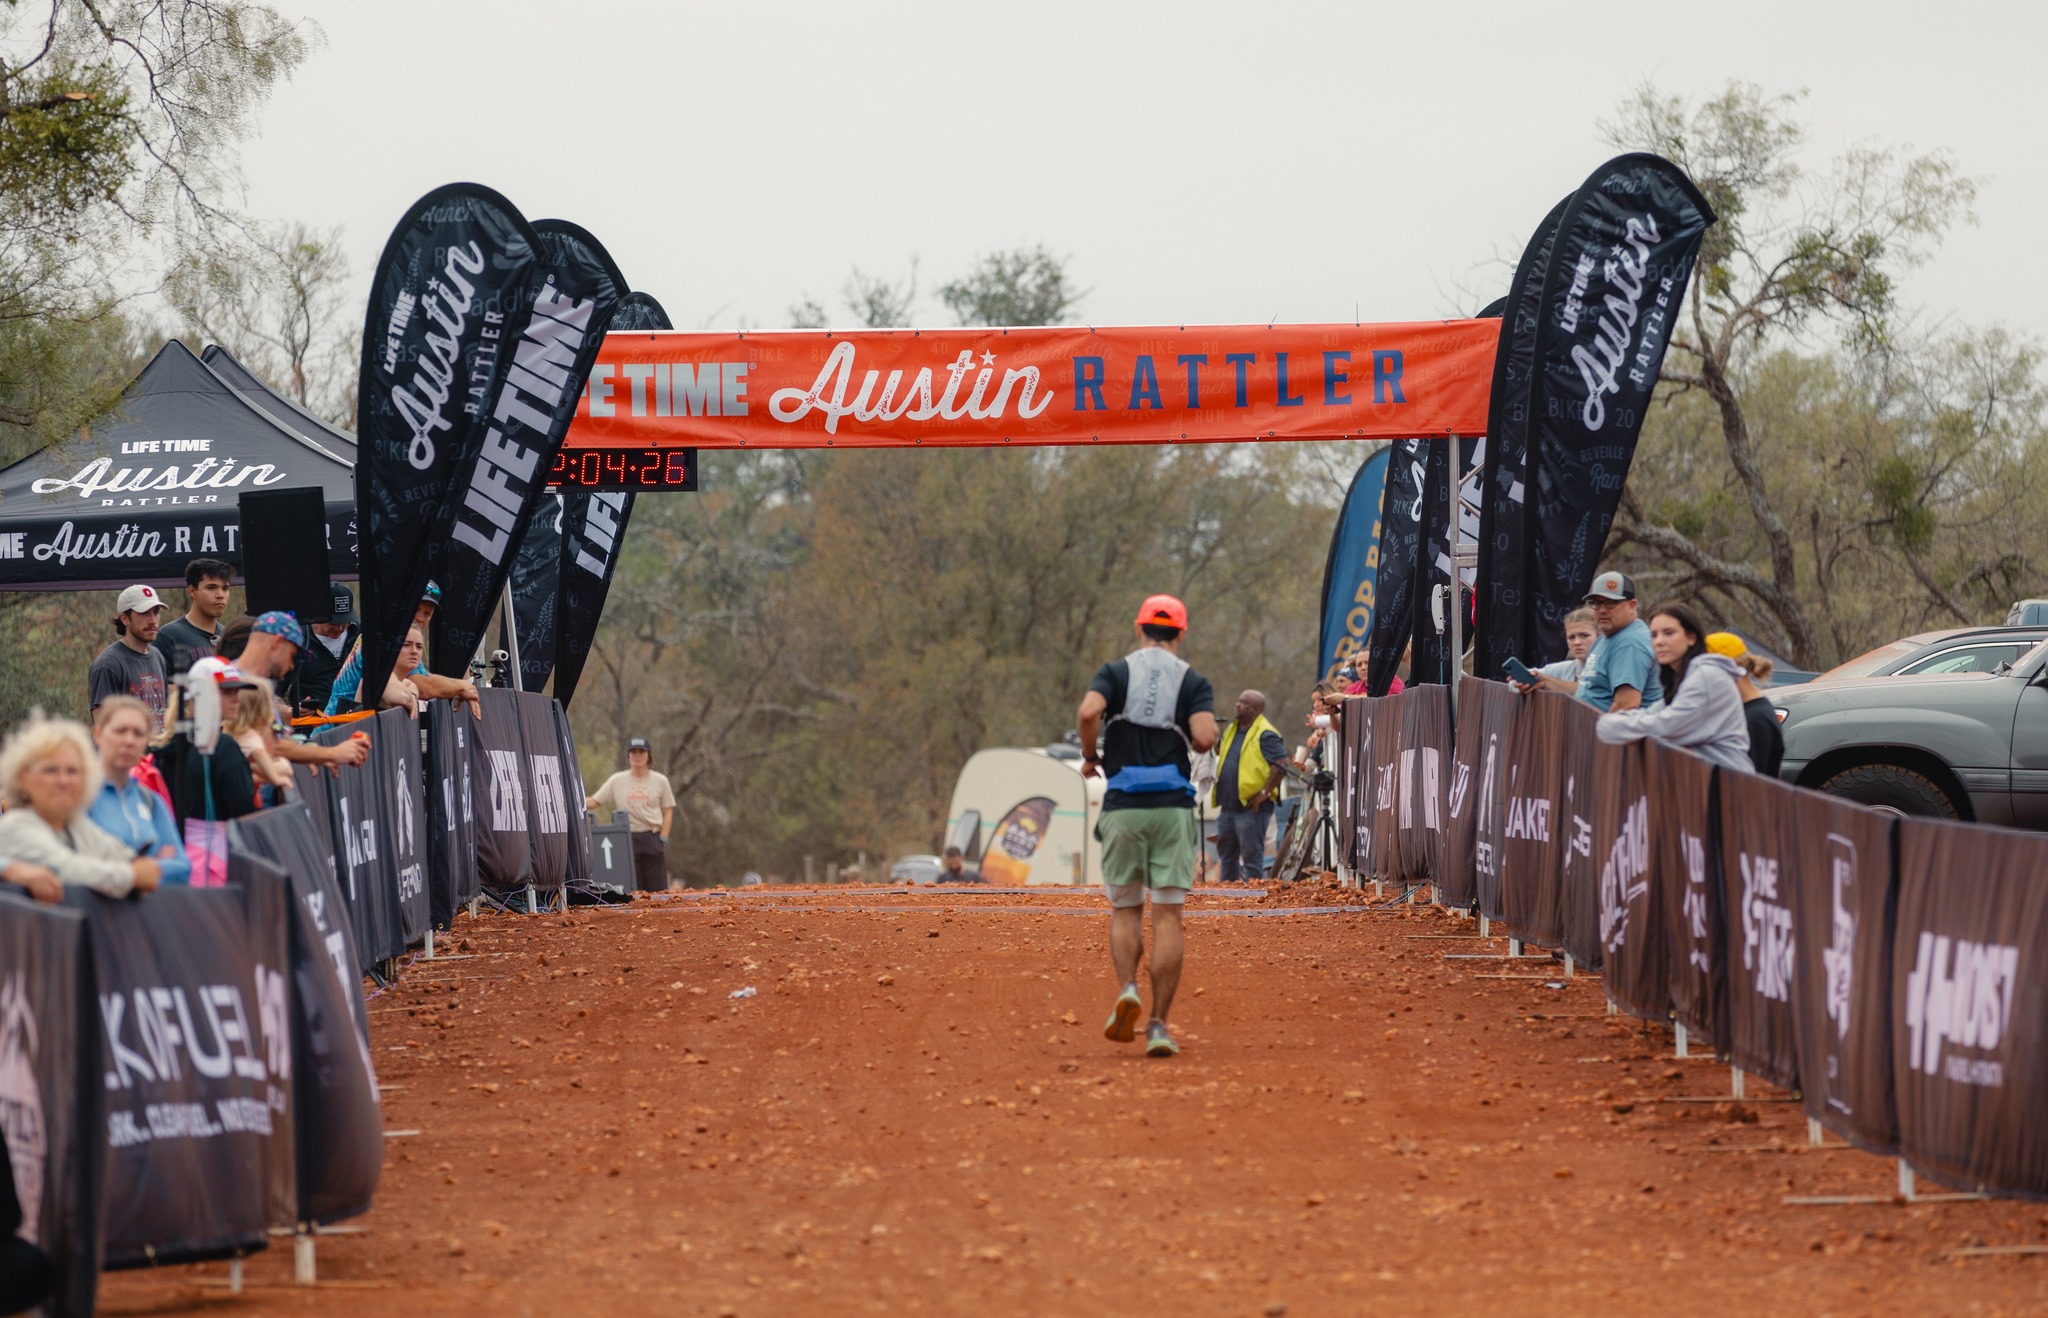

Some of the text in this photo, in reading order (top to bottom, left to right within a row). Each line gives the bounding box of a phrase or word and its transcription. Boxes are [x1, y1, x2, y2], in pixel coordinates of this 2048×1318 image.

[383, 289, 417, 375] LIFE TIME
[391, 240, 484, 470] Austin
[464, 312, 504, 416] RATTLER
[493, 282, 595, 436] TIME
[1140, 340, 1175, 354] BIKE
[1571, 213, 1662, 431] Austin
[1629, 277, 1674, 384] RATTLER
[622, 362, 748, 417] TIME
[769, 341, 1407, 434] Austin RATTLER
[31, 456, 286, 498] Austin
[121, 440, 210, 454] LIFE TIME
[101, 495, 218, 506] RATTLER
[451, 426, 540, 566] LIFE
[33, 521, 166, 565] Austin
